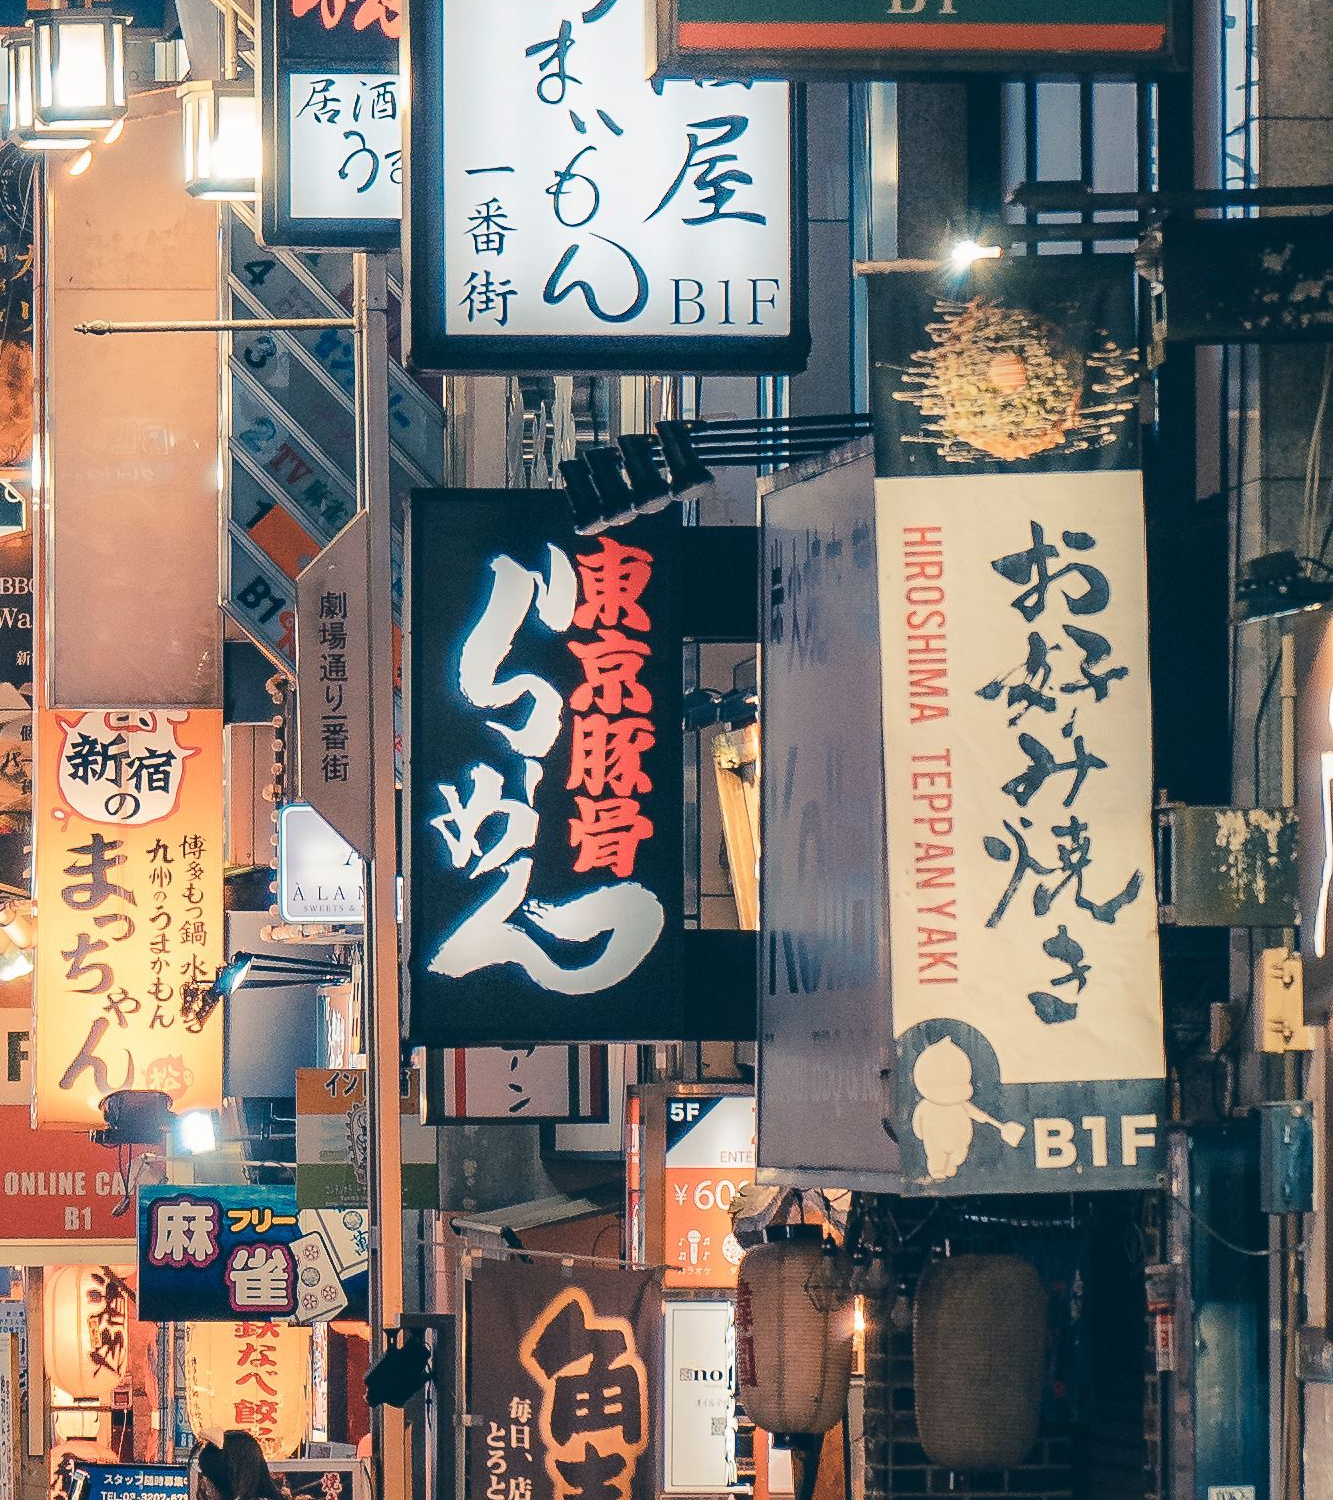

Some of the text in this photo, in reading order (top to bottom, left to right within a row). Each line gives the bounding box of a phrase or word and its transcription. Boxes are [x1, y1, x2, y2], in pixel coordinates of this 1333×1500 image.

[461, 166, 517, 327] 一番街
[671, 281, 780, 325] B1F
[902, 525, 950, 724] HIROSHIMA
[319, 591, 349, 783] 劇場通り一番街
[567, 535, 657, 879] 東京豚骨
[65, 735, 177, 795] 新宿
[105, 791, 140, 820] の
[977, 520, 1143, 1025] お好み焼き
[59, 833, 142, 1092] まっちゃん
[146, 839, 175, 1030] 九州のうまかもん
[670, 1102, 700, 1122] 5F
[1033, 1112, 1157, 1171] B1F
[64, 1206, 92, 1231] B1
[228, 1209, 296, 1233] フリー
